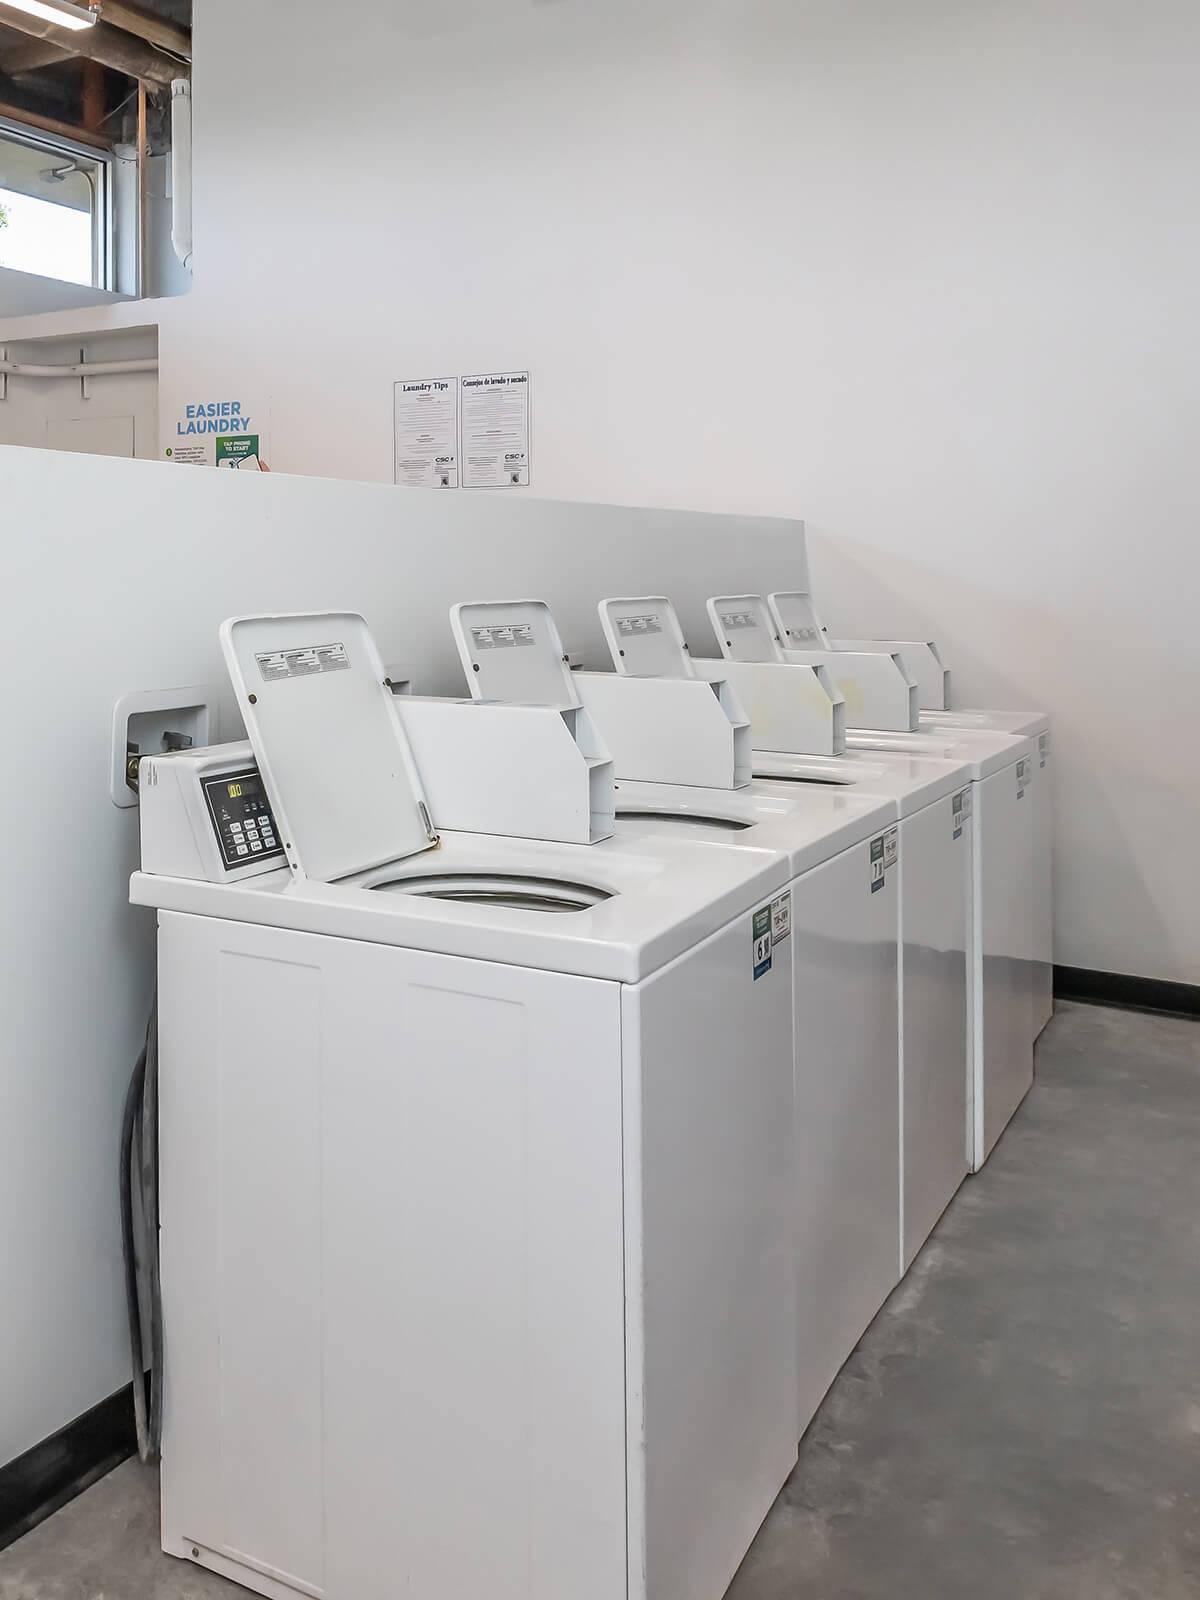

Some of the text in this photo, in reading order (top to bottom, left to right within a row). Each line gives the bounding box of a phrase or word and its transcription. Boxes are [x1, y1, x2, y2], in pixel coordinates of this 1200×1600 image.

[403, 381, 449, 392] Laundry Tips
[185, 401, 241, 419] EASIER
[176, 417, 251, 435] LAUNDRY
[757, 940, 763, 961] 6
